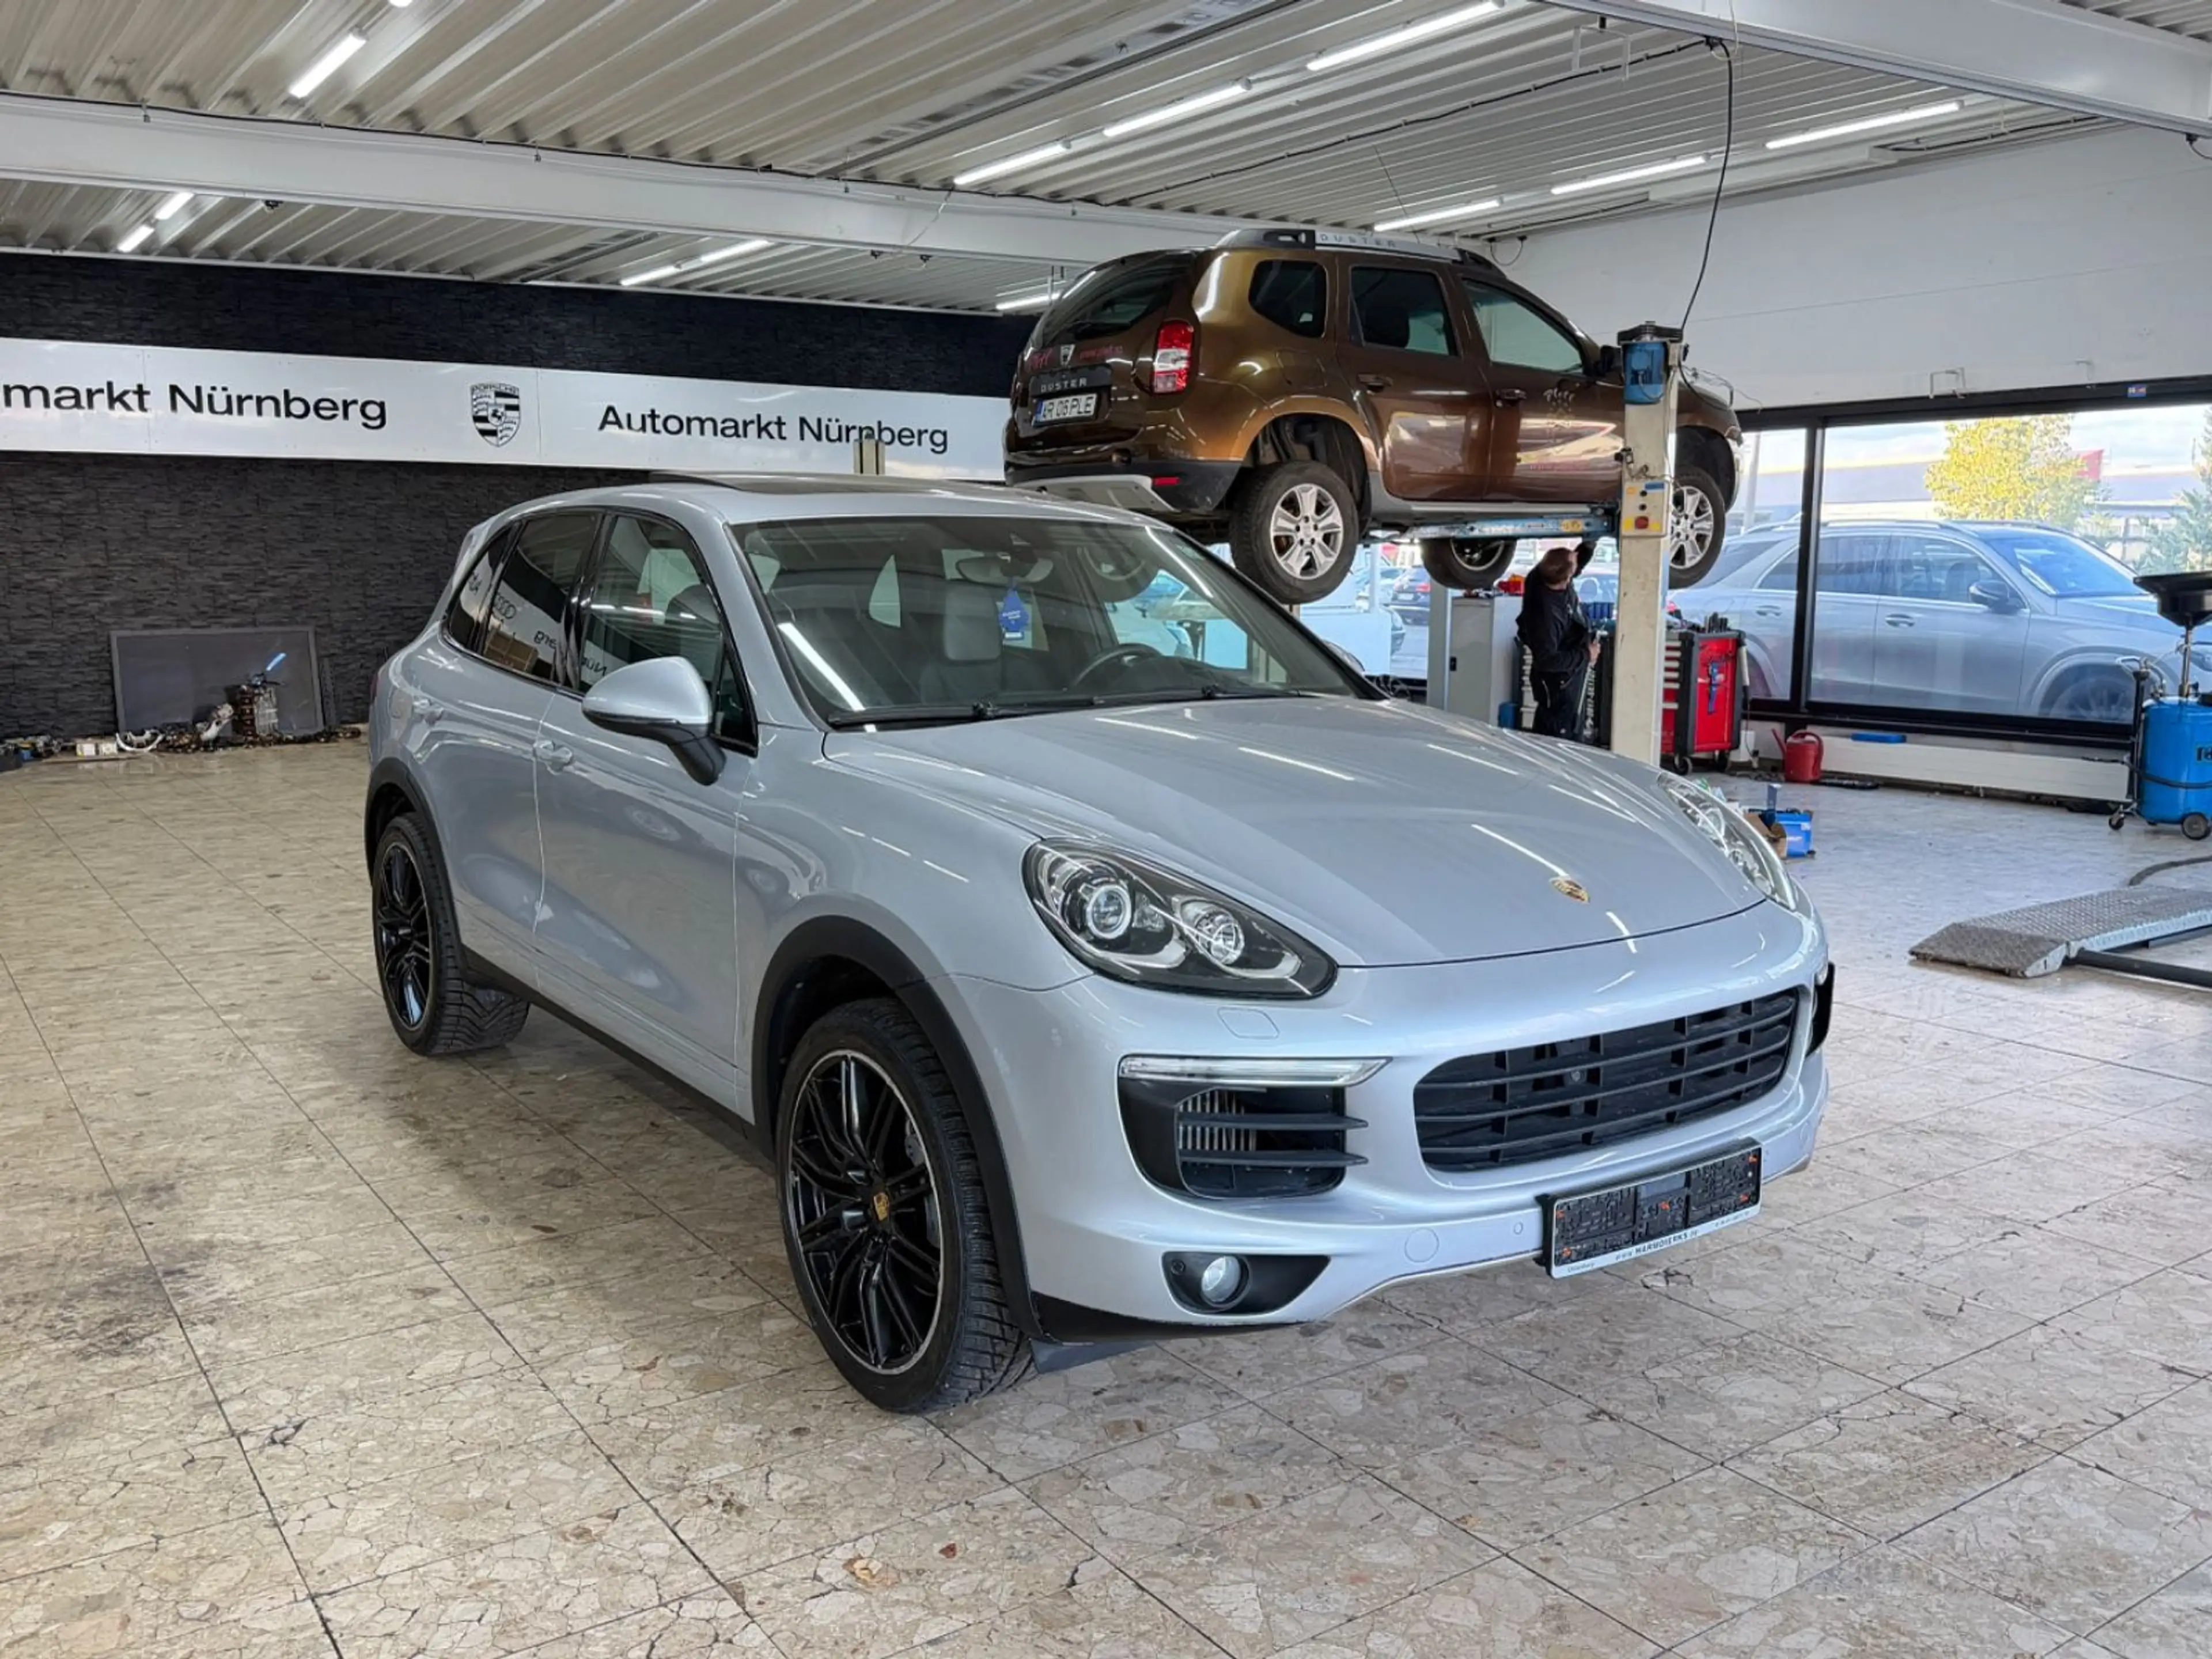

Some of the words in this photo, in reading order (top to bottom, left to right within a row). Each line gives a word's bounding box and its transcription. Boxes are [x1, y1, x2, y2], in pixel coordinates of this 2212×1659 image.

[3, 380, 150, 412] markt
[169, 384, 387, 430] Nürnberg
[1041, 377, 1087, 393] DUSTER
[599, 405, 787, 441] Automarkt
[799, 416, 948, 454] Nürnberg
